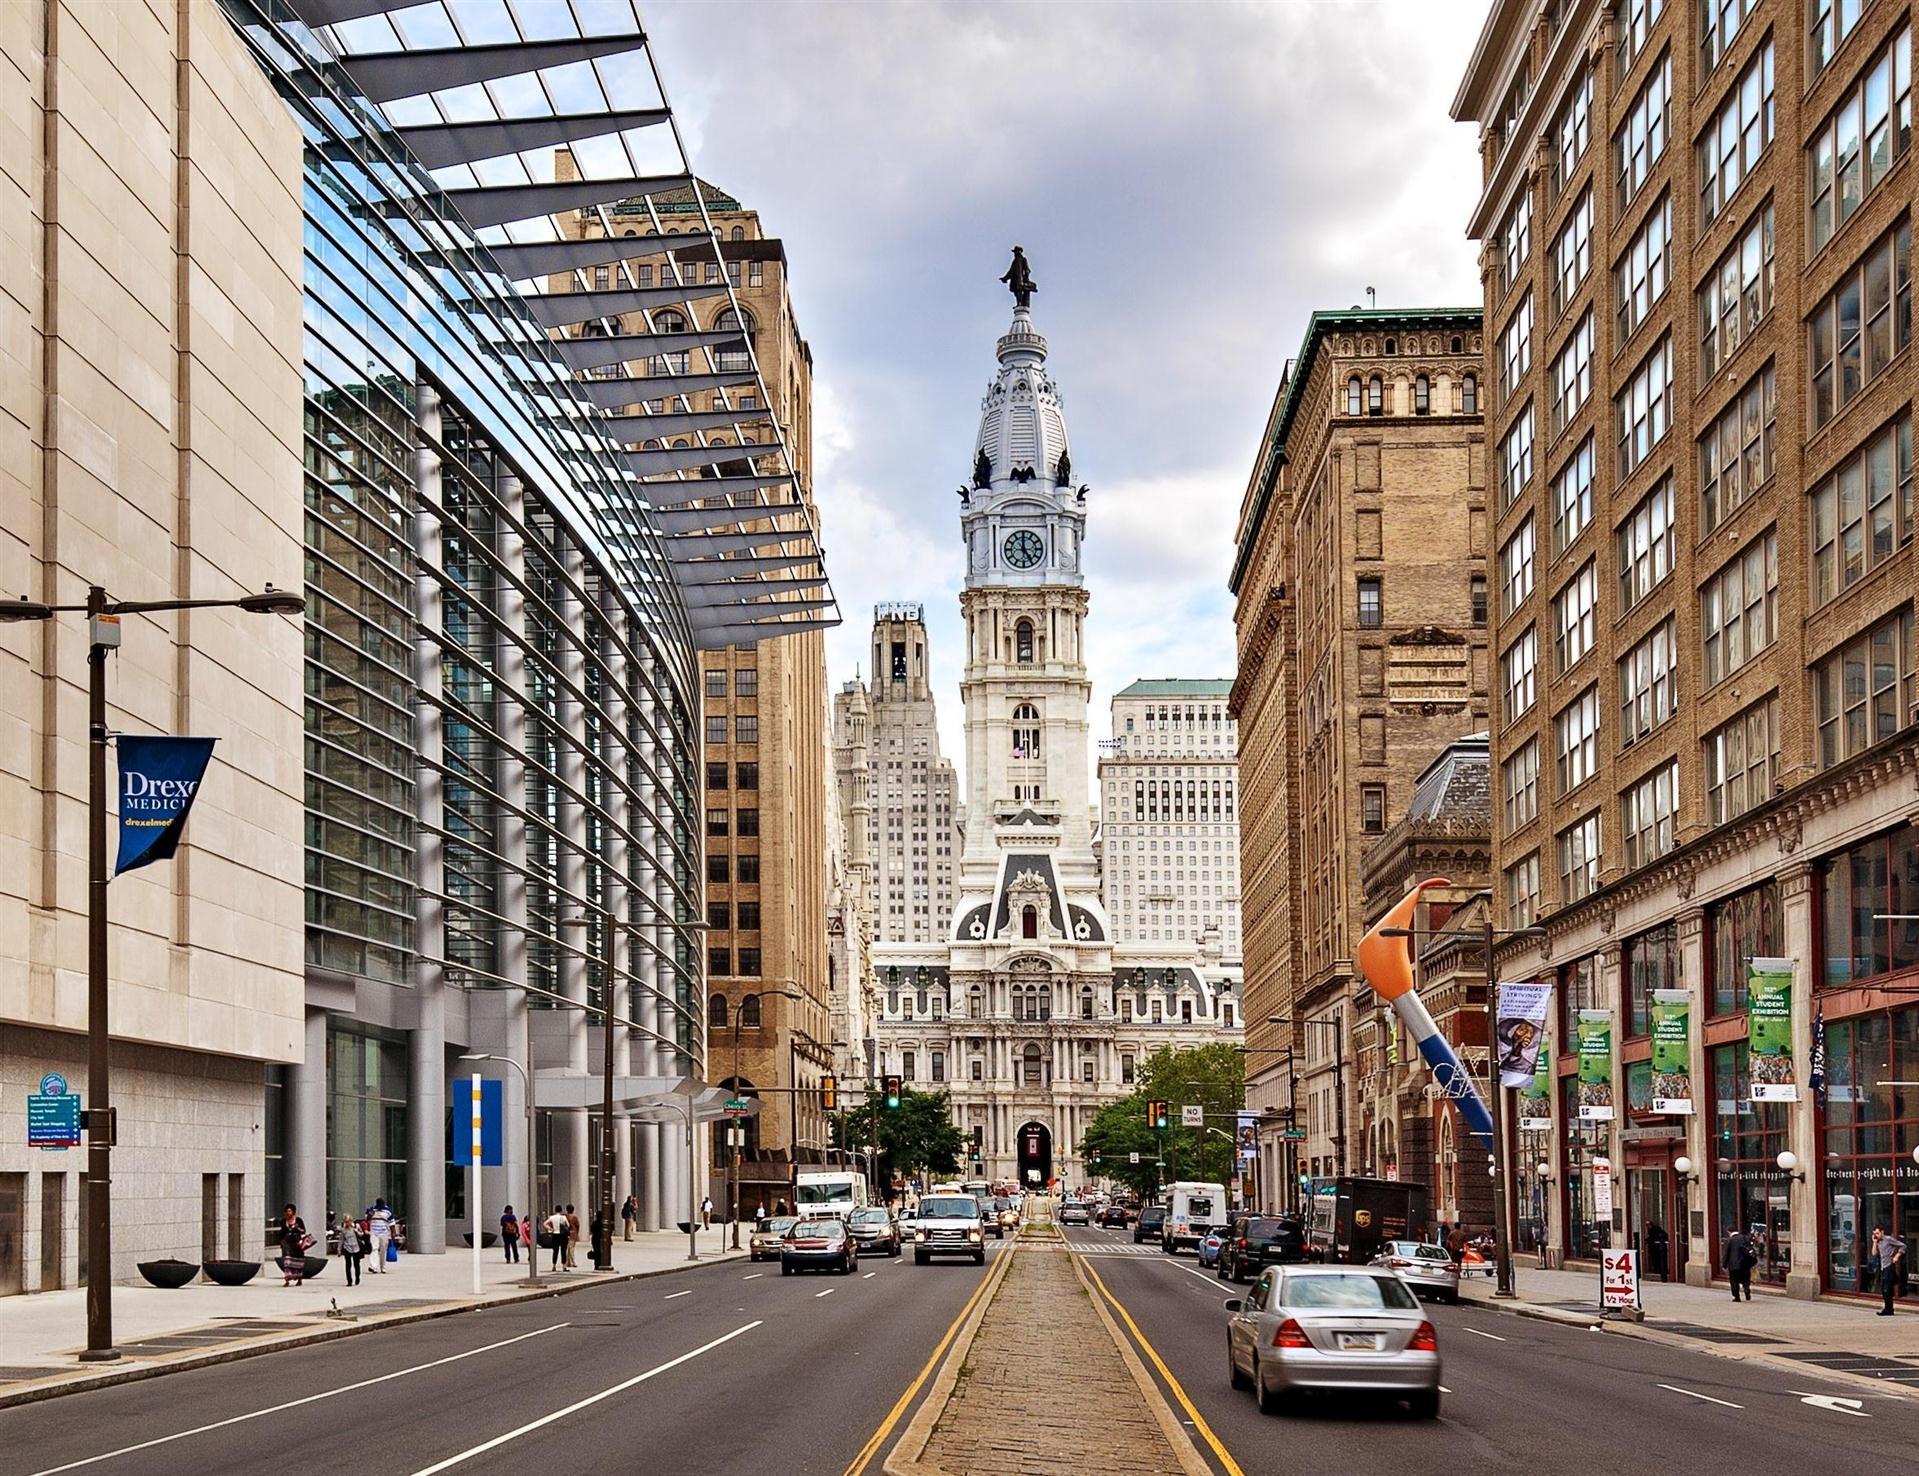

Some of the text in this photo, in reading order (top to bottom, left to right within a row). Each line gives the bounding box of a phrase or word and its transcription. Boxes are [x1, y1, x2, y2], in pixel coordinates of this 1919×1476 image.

[1882, 1167, 1903, 1177] North
[1907, 1167, 1919, 1177] Bro
[1618, 1274, 1632, 1285] 1st
[1619, 1296, 1635, 1304] Hour
